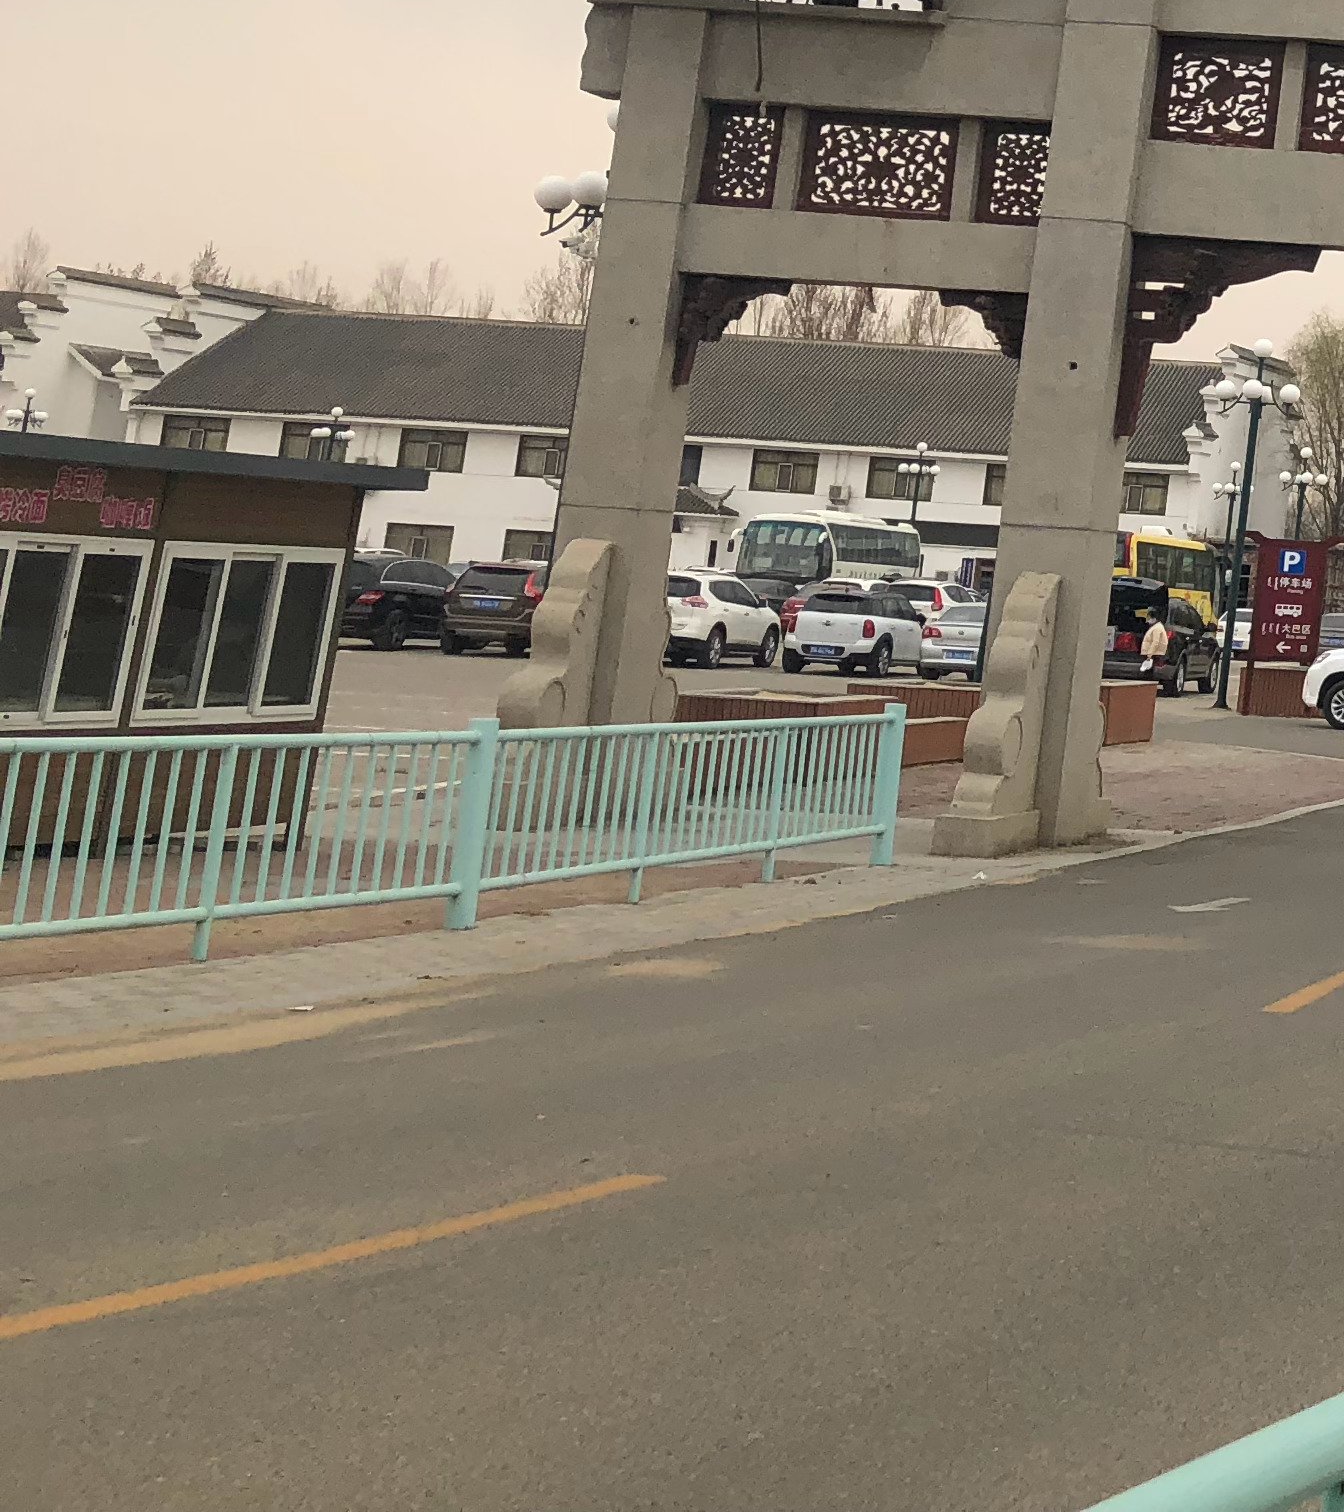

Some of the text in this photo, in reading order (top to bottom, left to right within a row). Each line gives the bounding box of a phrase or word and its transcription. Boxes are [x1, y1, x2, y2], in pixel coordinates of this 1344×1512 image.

[52, 465, 107, 503] 臭豆腐
[1283, 551, 1301, 572] P
[1279, 576, 1313, 590] 停车场
[1281, 623, 1312, 635] 大巴区
